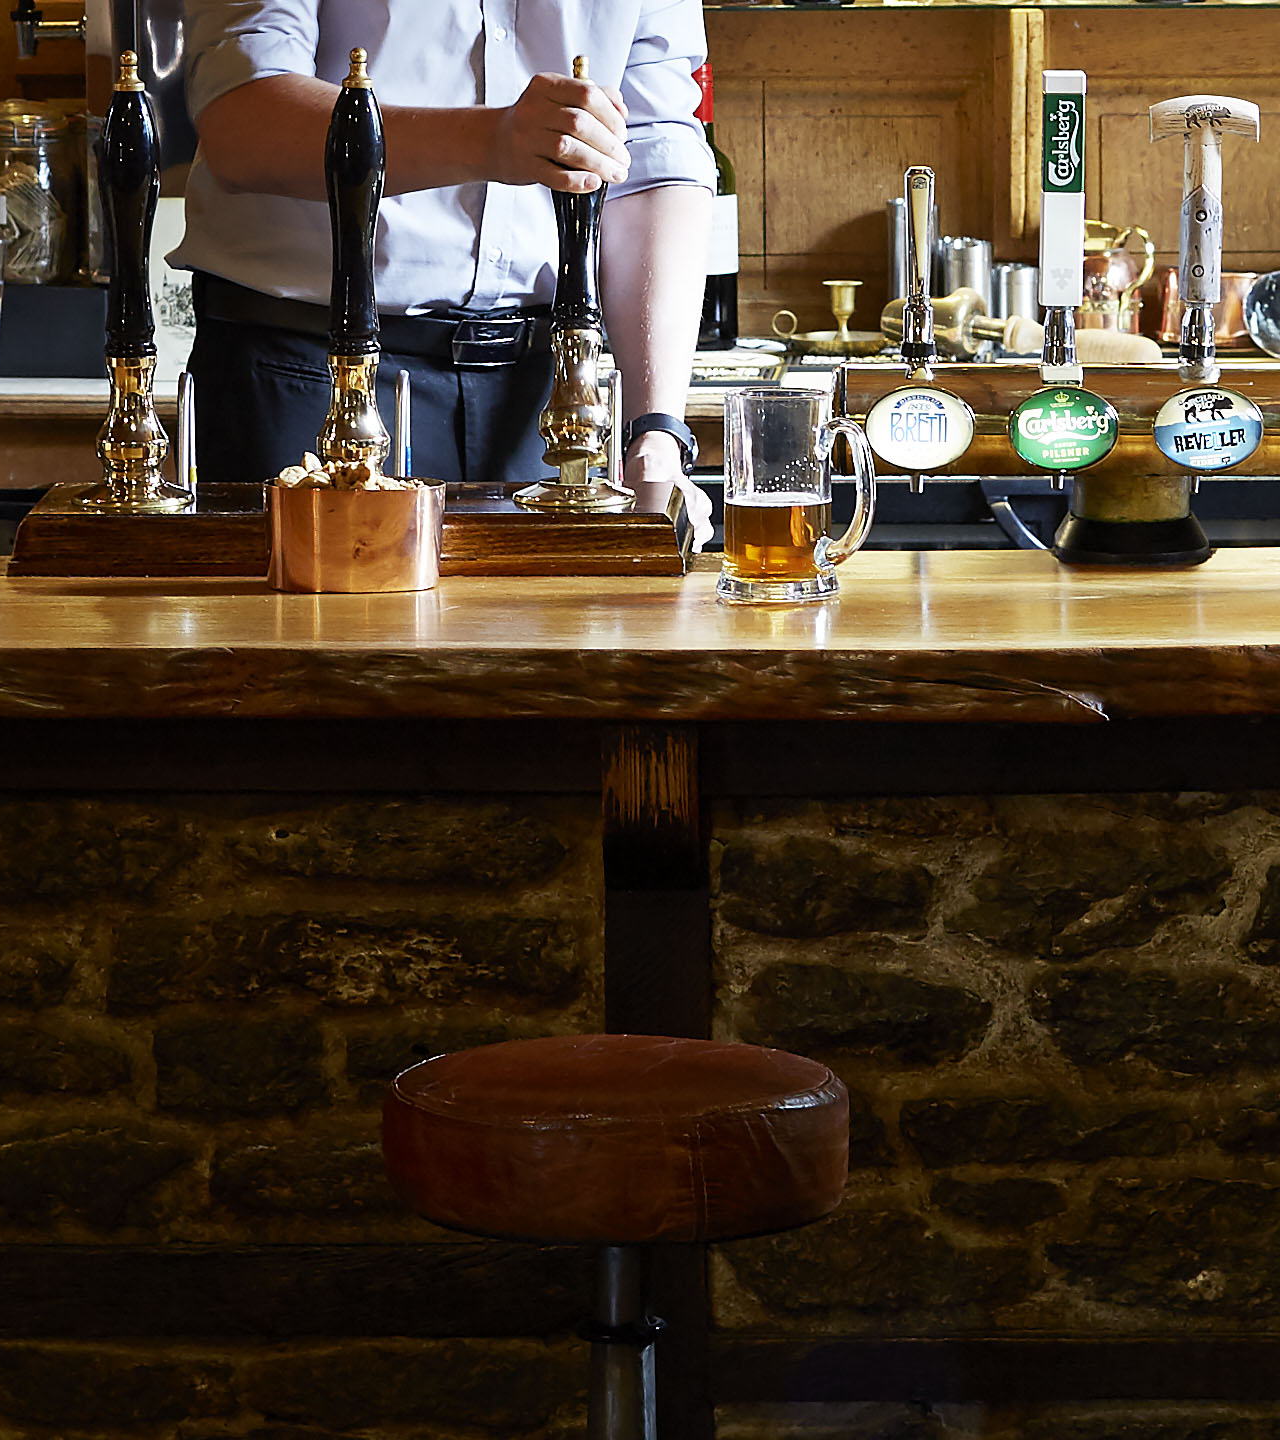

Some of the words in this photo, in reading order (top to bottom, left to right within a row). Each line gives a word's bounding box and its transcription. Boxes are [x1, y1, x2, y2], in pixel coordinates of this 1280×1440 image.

[1046, 99, 1079, 187] Carlsberg
[1178, 392, 1226, 412] ORCHARD
[1195, 400, 1214, 412] PIG
[890, 413, 948, 443] PORETTI
[1018, 404, 1110, 438] Carlsberg
[1041, 447, 1090, 458] PILSNER
[1173, 428, 1246, 454] REVELLER
